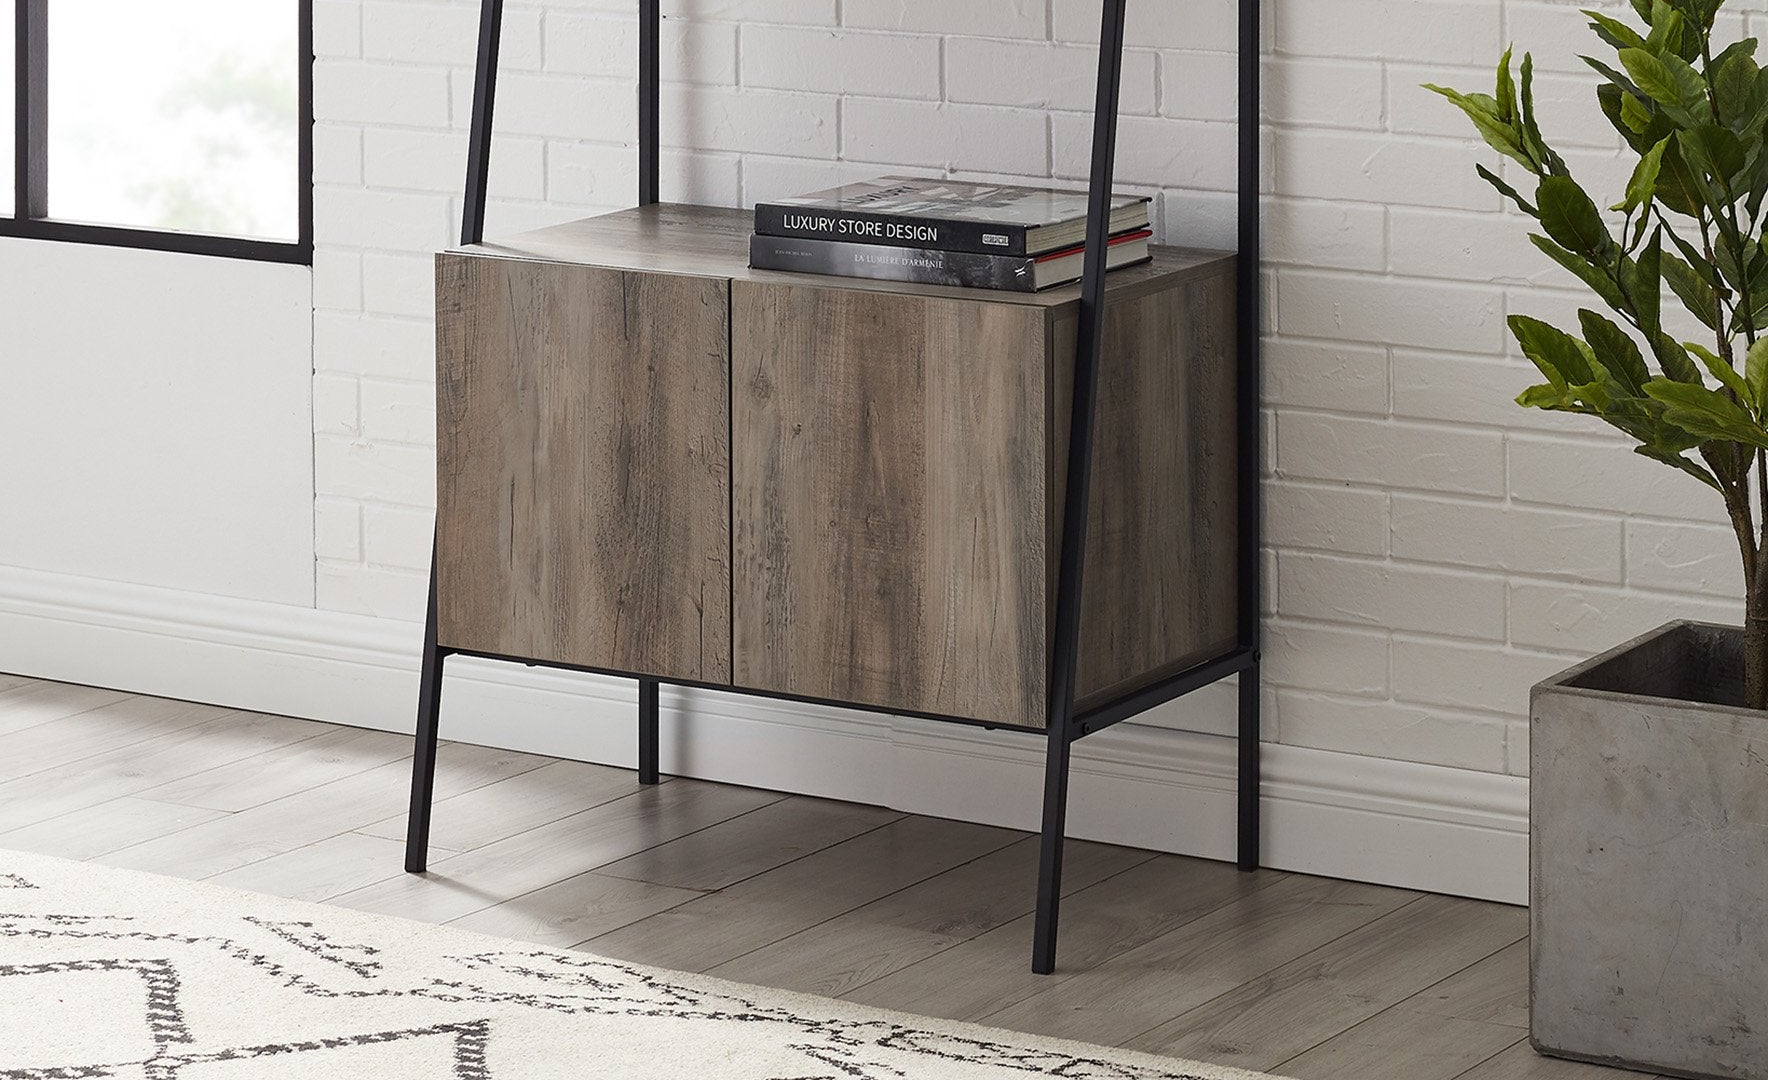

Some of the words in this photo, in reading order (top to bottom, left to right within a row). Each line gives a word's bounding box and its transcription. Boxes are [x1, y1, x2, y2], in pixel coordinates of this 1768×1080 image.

[783, 214, 836, 233] LUXURY
[838, 219, 883, 237] STORE
[886, 224, 938, 242] DESIGN
[854, 254, 865, 263] LA
